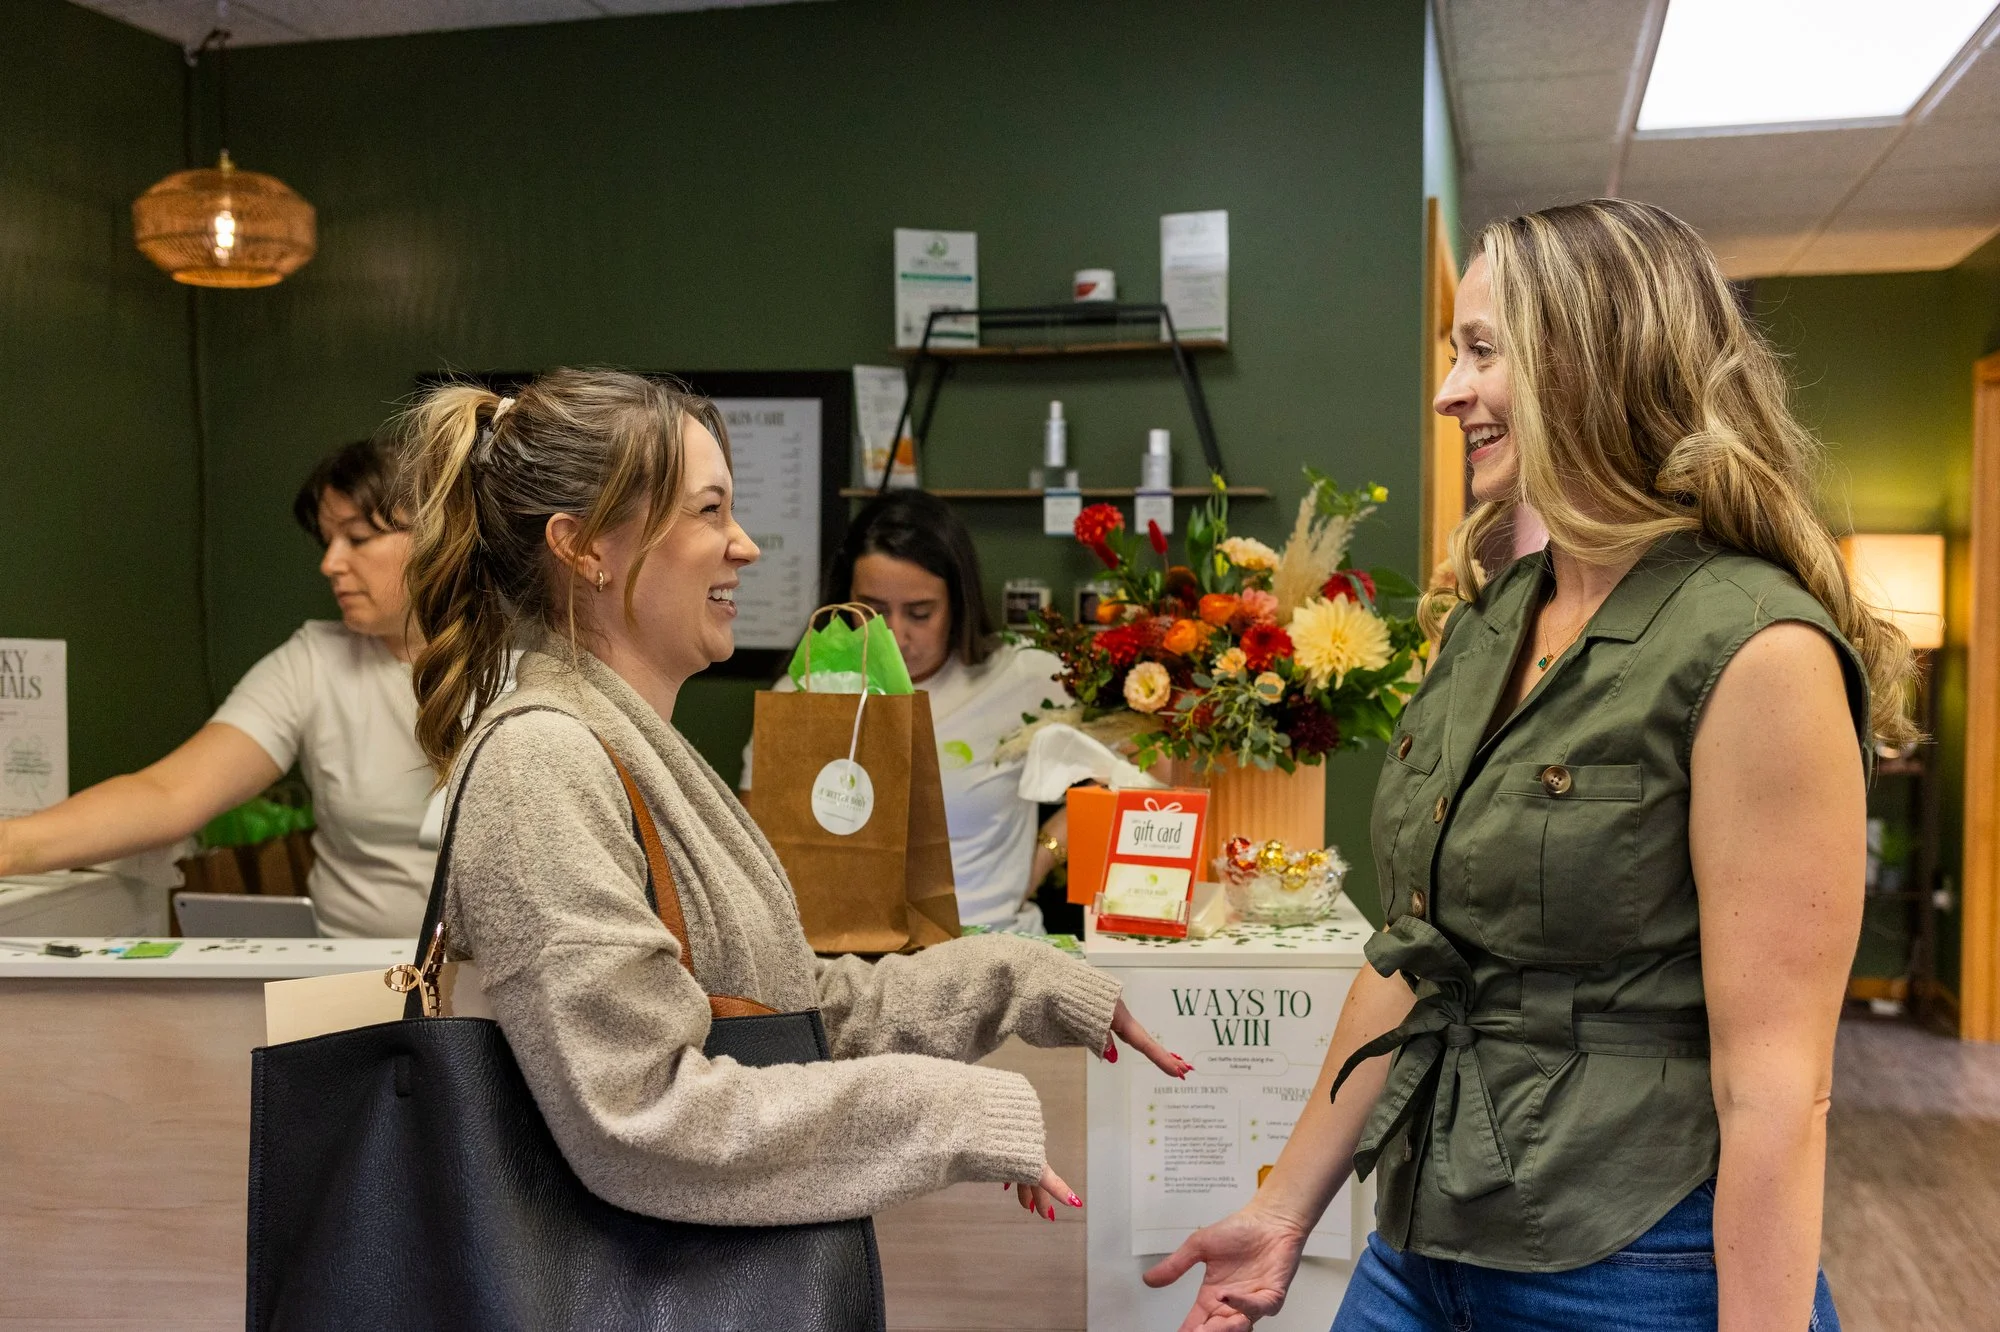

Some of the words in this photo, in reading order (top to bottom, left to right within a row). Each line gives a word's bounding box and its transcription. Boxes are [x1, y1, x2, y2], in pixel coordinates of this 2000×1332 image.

[1133, 820, 1154, 846] gift
[1157, 821, 1183, 843] card
[1171, 988, 1265, 1017] WAYS
[1274, 989, 1312, 1018] TO
[1211, 1019, 1270, 1046] WIN
